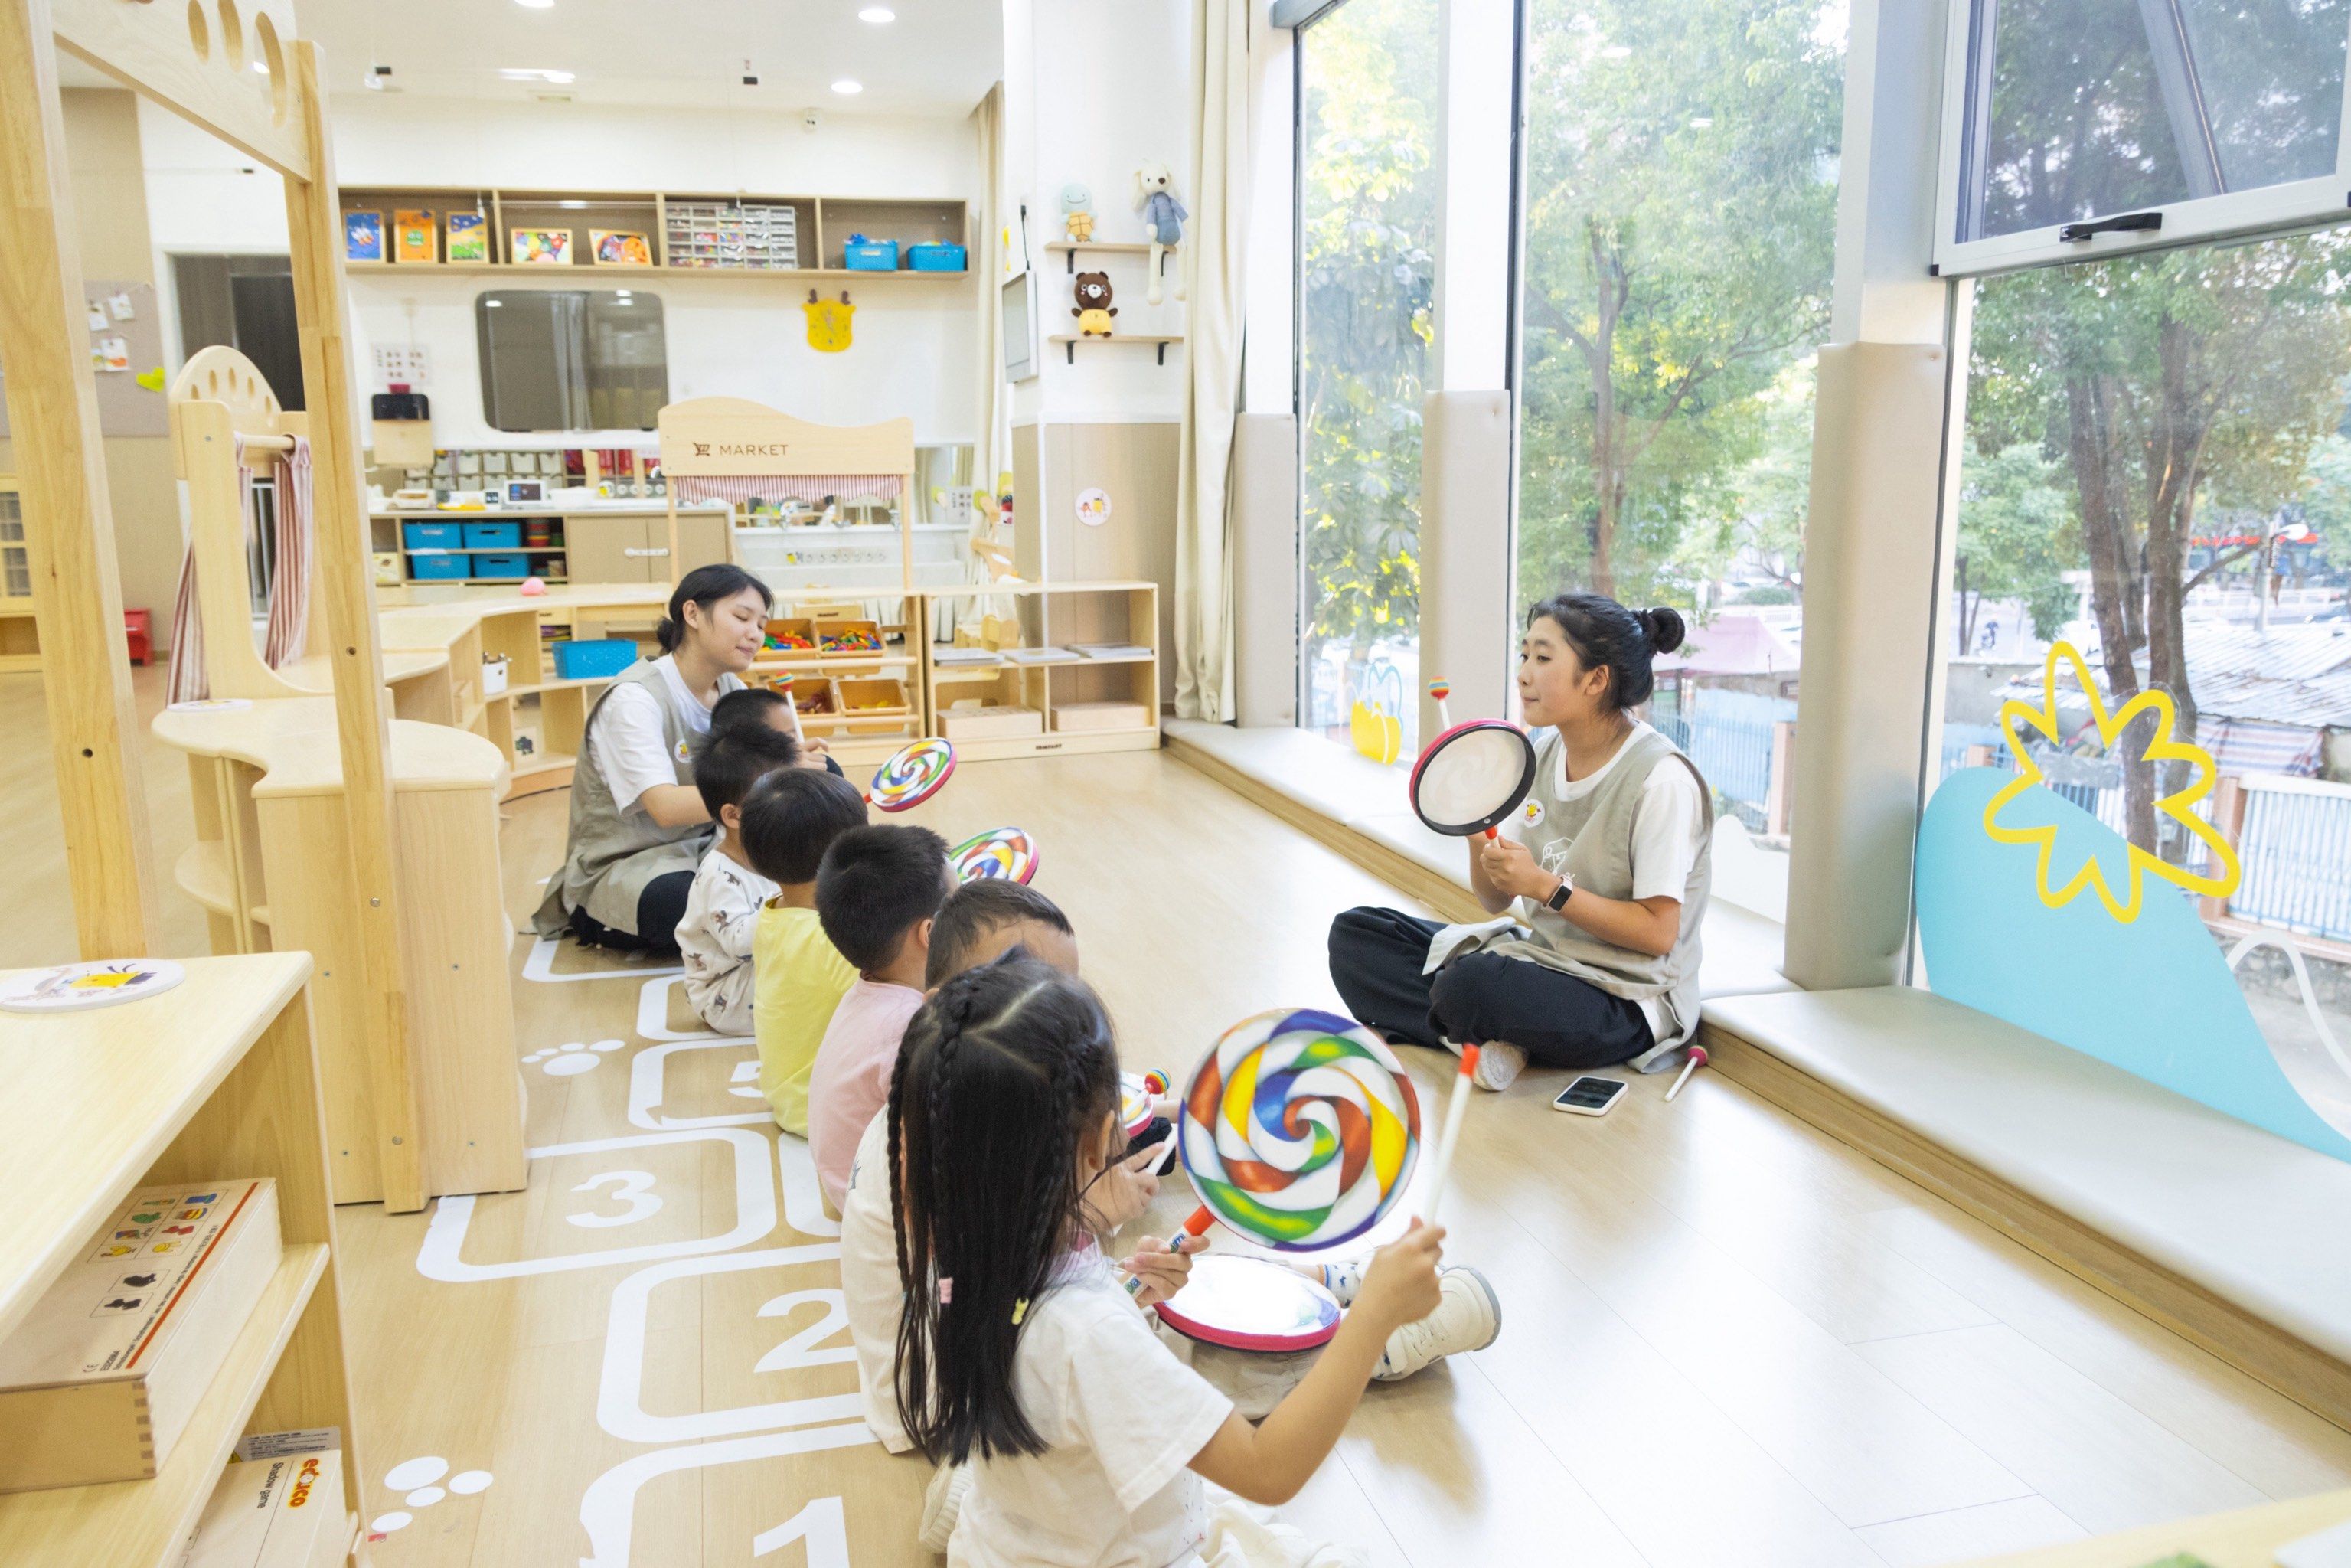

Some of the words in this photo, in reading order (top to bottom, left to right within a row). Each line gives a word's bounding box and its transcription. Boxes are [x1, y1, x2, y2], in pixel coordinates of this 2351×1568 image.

[719, 444, 789, 456] MARKET
[566, 1170, 663, 1228] 3
[753, 1288, 858, 1374] 2
[265, 1462, 284, 1488] Shadow
[256, 1489, 272, 1509] game
[753, 1495, 851, 1568] 1
